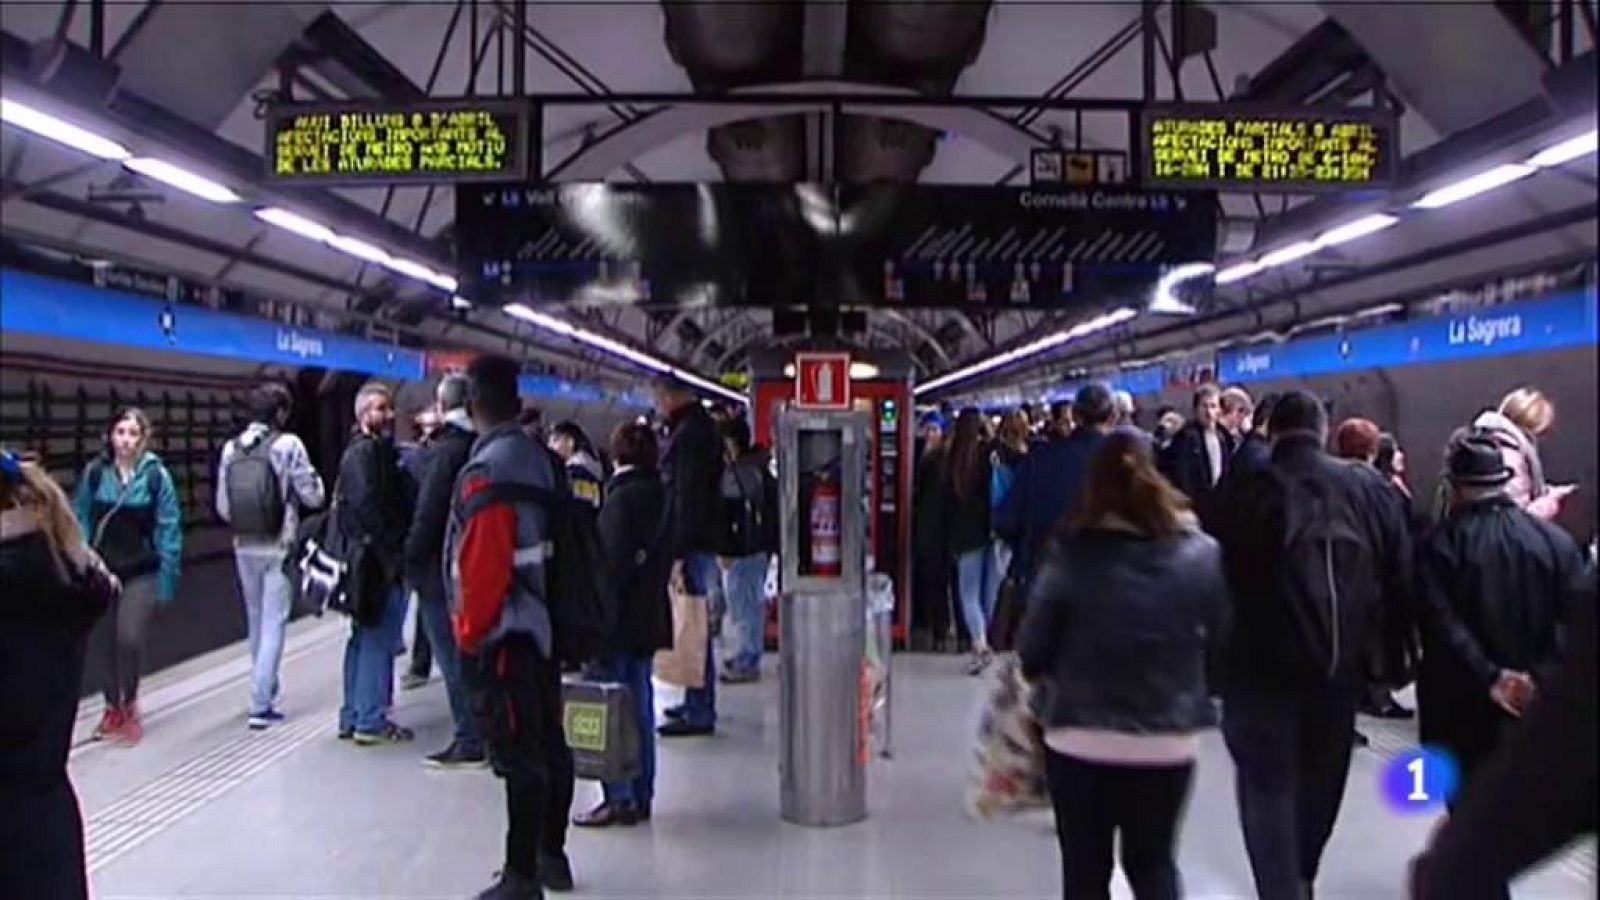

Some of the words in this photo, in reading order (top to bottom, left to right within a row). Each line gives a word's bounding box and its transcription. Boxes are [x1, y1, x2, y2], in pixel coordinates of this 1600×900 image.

[340, 112, 404, 129] DILLUNS
[386, 126, 477, 142] IMPORTANTS
[1234, 121, 1306, 137] PARCIALS
[1331, 123, 1378, 139] ABRIL
[365, 141, 414, 156] METRO
[1152, 134, 1254, 149] AFECTACIONS
[1263, 135, 1351, 150] IMPORTANTS
[337, 156, 413, 172] ATURADES
[1243, 149, 1290, 164] METRO
[1448, 319, 1465, 345] La
[1467, 313, 1521, 346] Sagrera
[277, 328, 290, 350] La
[291, 330, 324, 358] Sagrera
